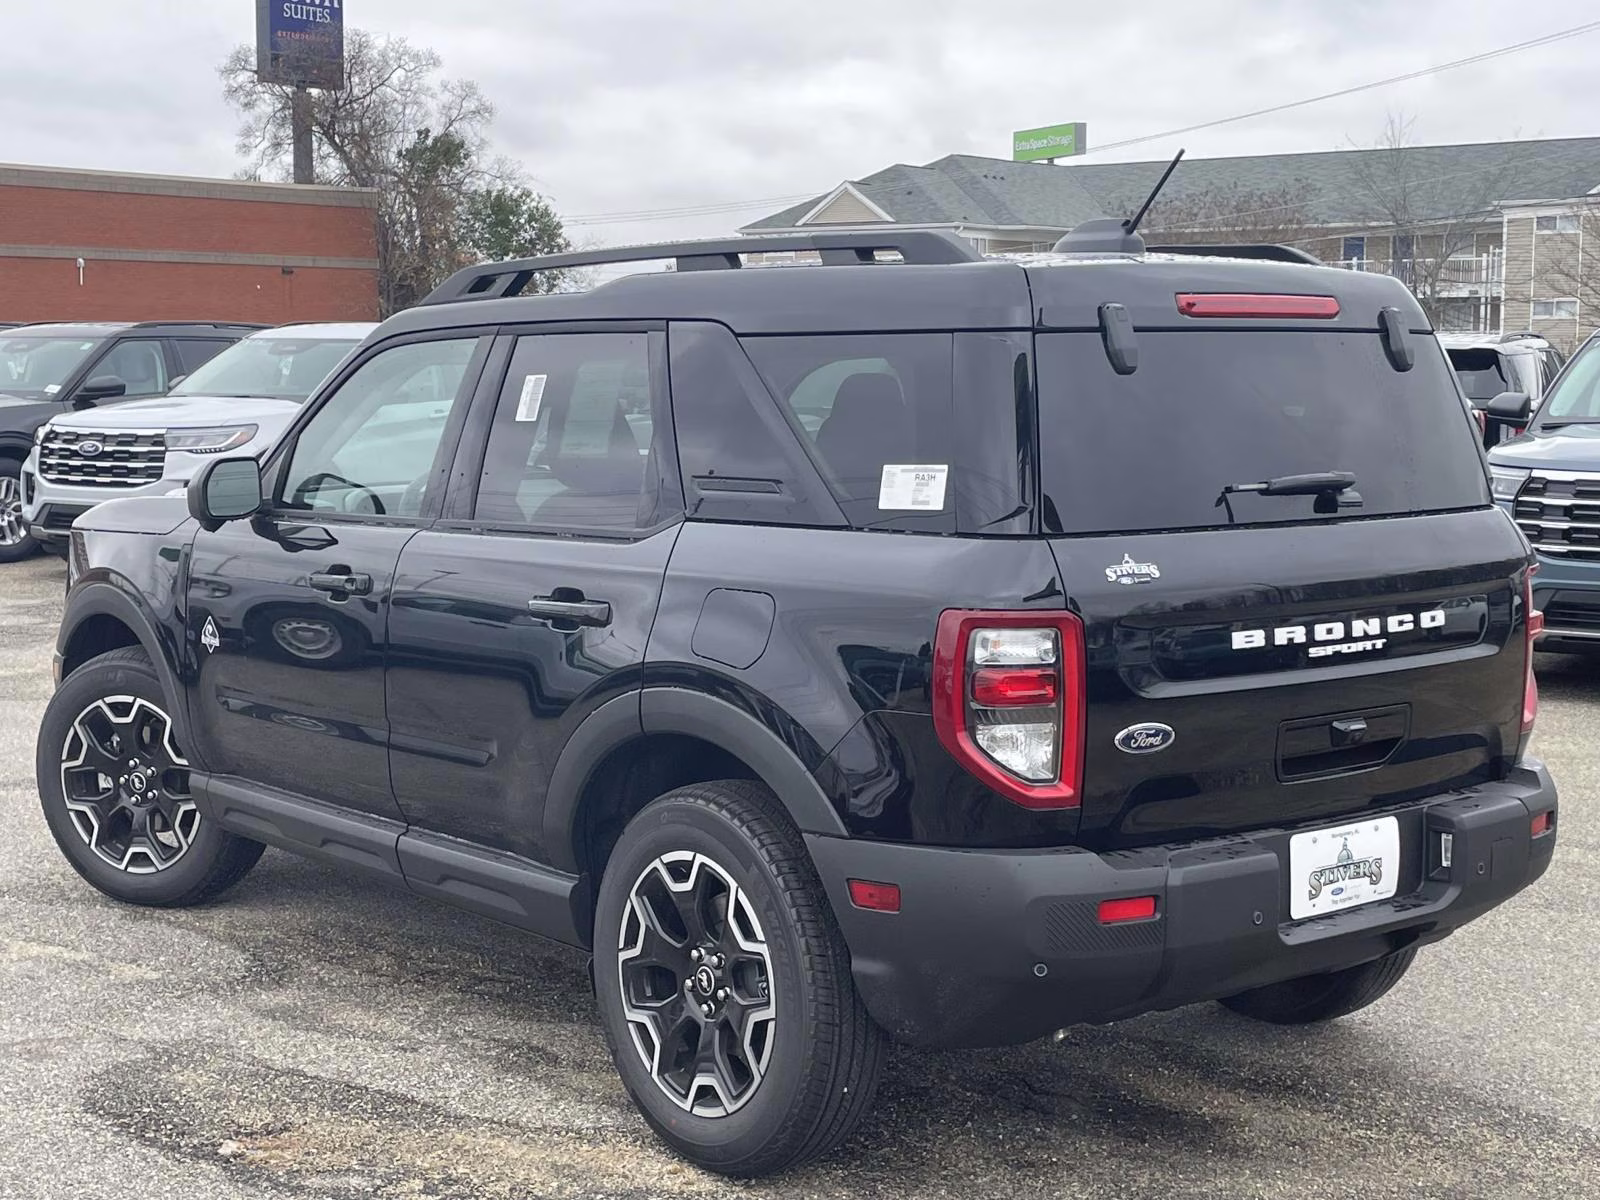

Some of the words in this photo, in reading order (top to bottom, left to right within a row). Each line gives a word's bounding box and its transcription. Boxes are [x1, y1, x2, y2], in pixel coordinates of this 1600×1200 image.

[283, 3, 331, 23] SUITES
[1105, 564, 1160, 582] STIVERS
[1231, 609, 1446, 650] BRONCO
[1308, 638, 1387, 658] SPORT
[1130, 729, 1164, 748] Ford
[1308, 857, 1382, 901] STIVERS
